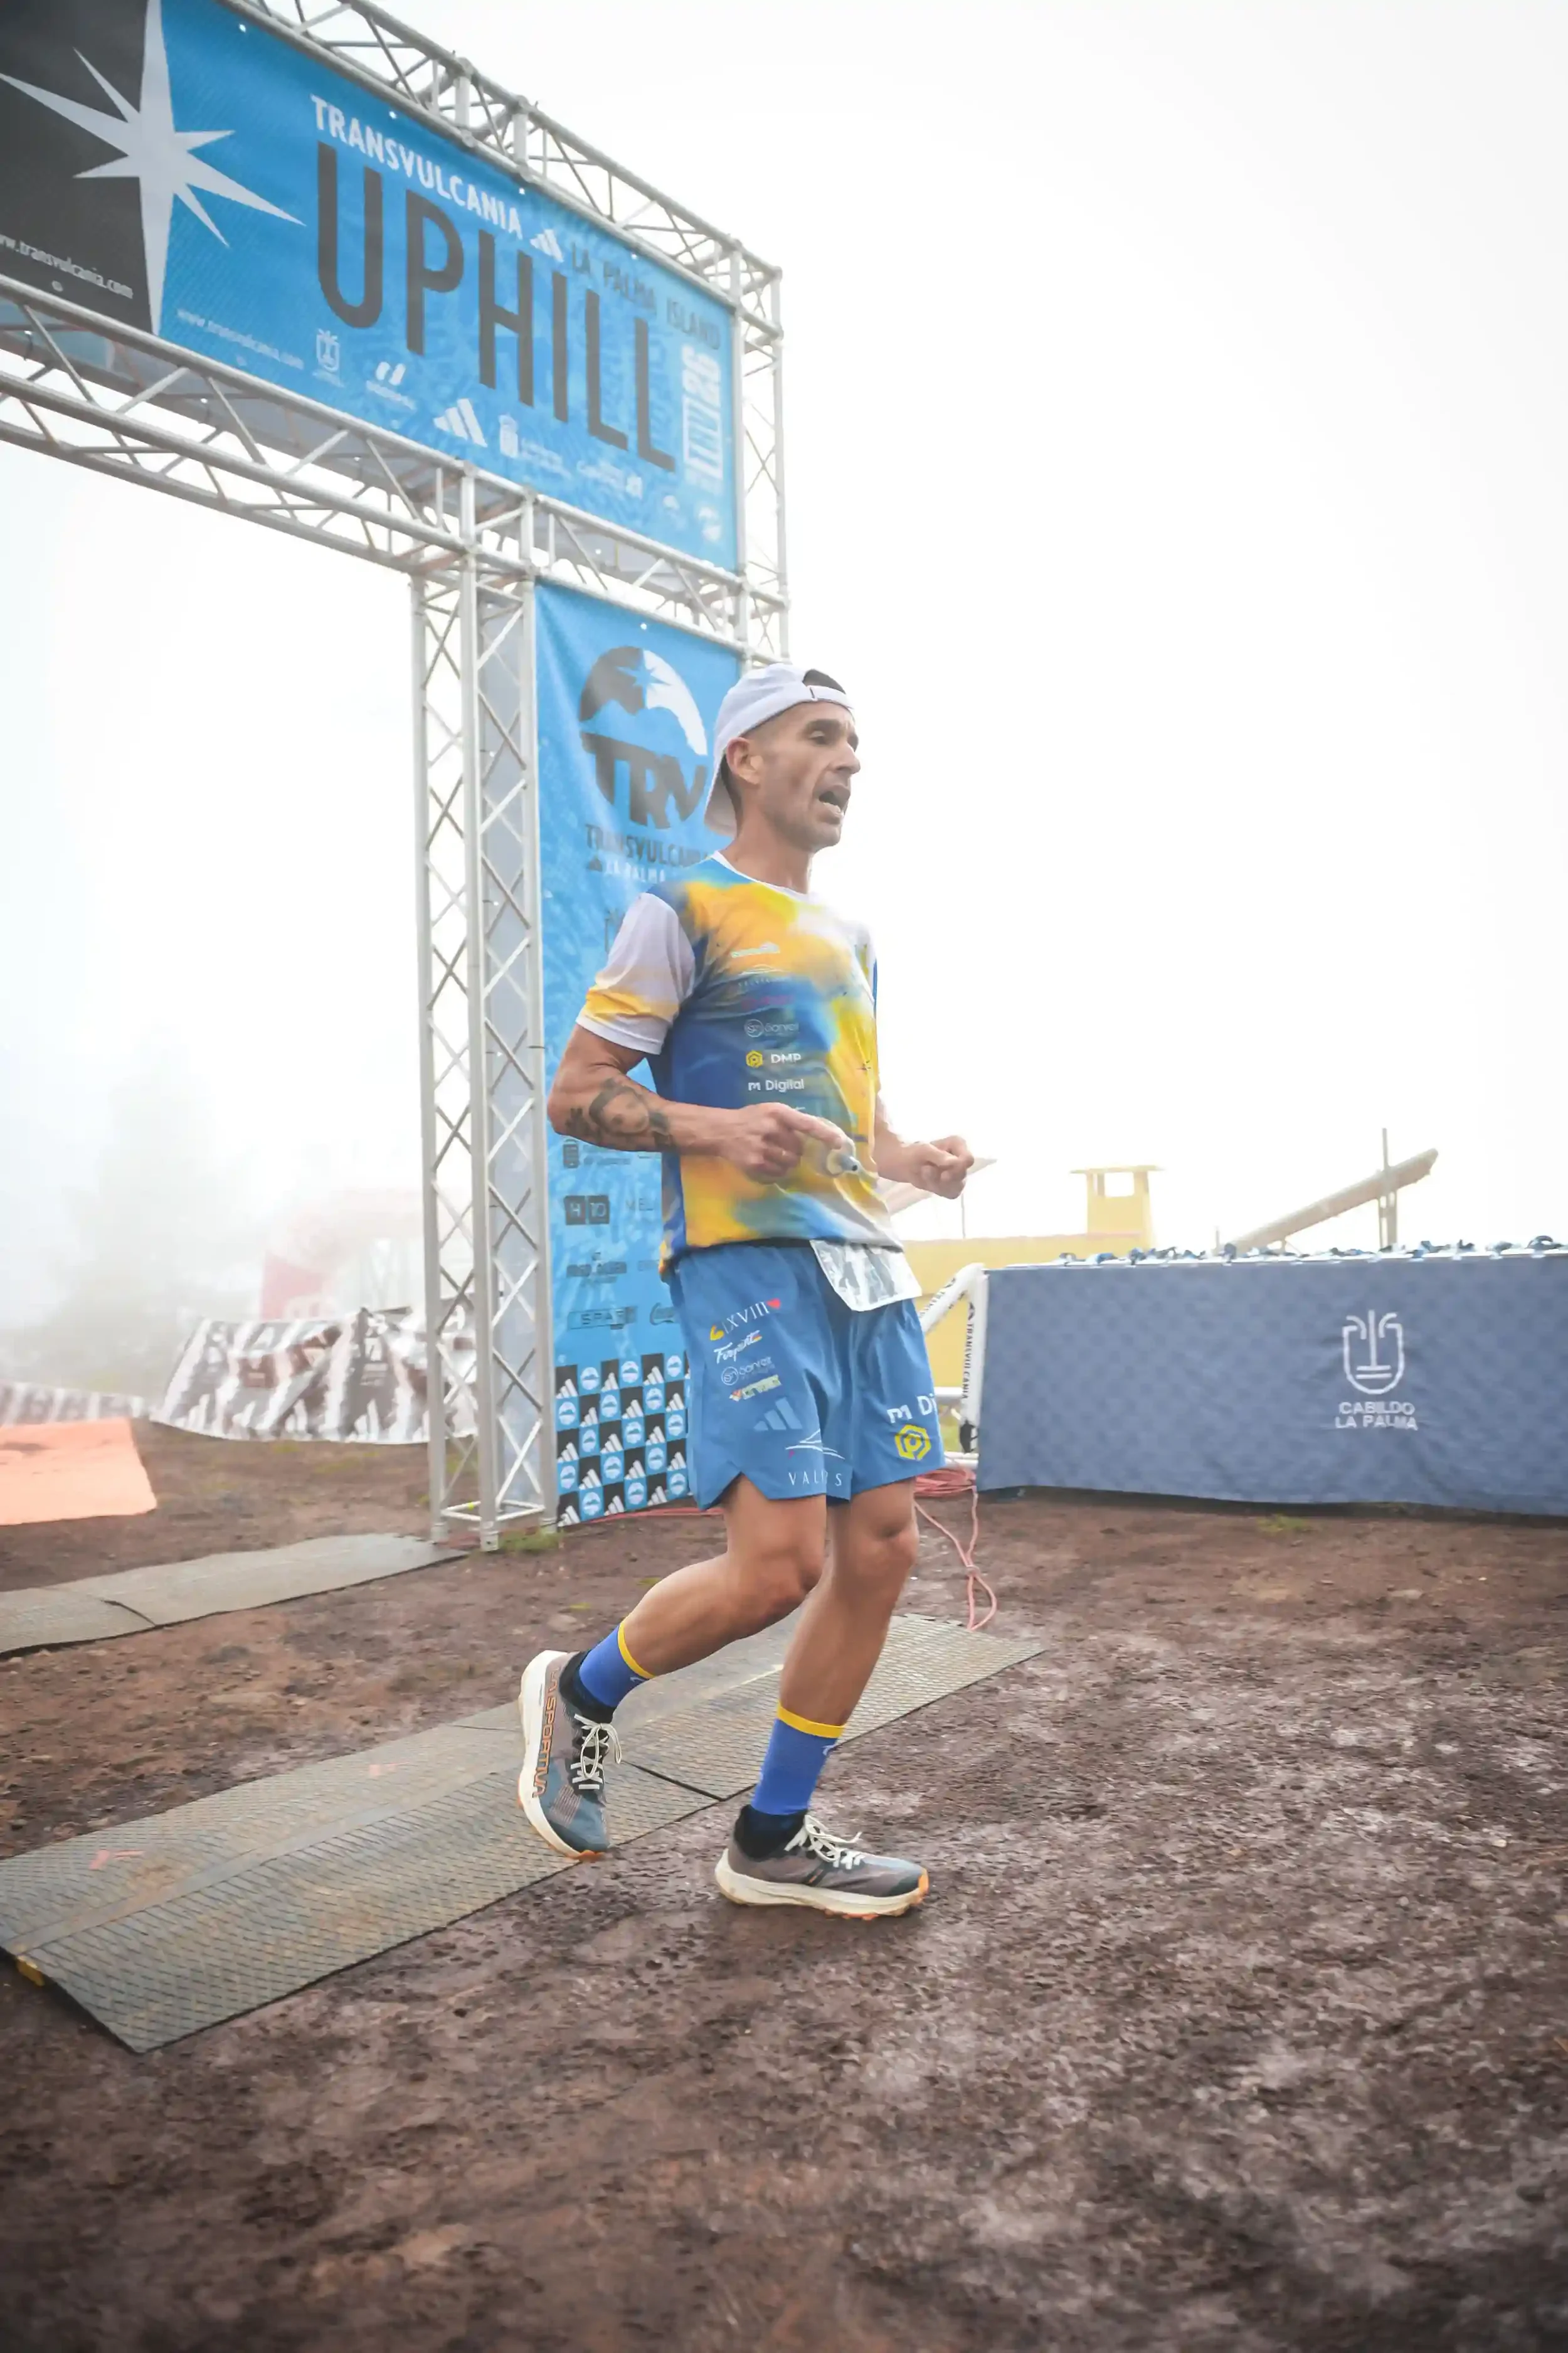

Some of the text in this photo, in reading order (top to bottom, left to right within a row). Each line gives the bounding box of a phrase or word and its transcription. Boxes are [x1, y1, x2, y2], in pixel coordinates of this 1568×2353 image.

[310, 93, 524, 240] TRANSVULCANIA
[317, 141, 675, 473] UPHILL
[572, 242, 591, 275] LA
[603, 260, 657, 316] PALMA
[581, 731, 708, 829] TRV
[765, 1078, 805, 1093] Digital
[770, 1053, 802, 1064] DMP
[1335, 1415, 1419, 1431] LA PALMA
[1338, 1401, 1416, 1416] CABILDO
[532, 1696, 557, 1798] SPORTIVA
